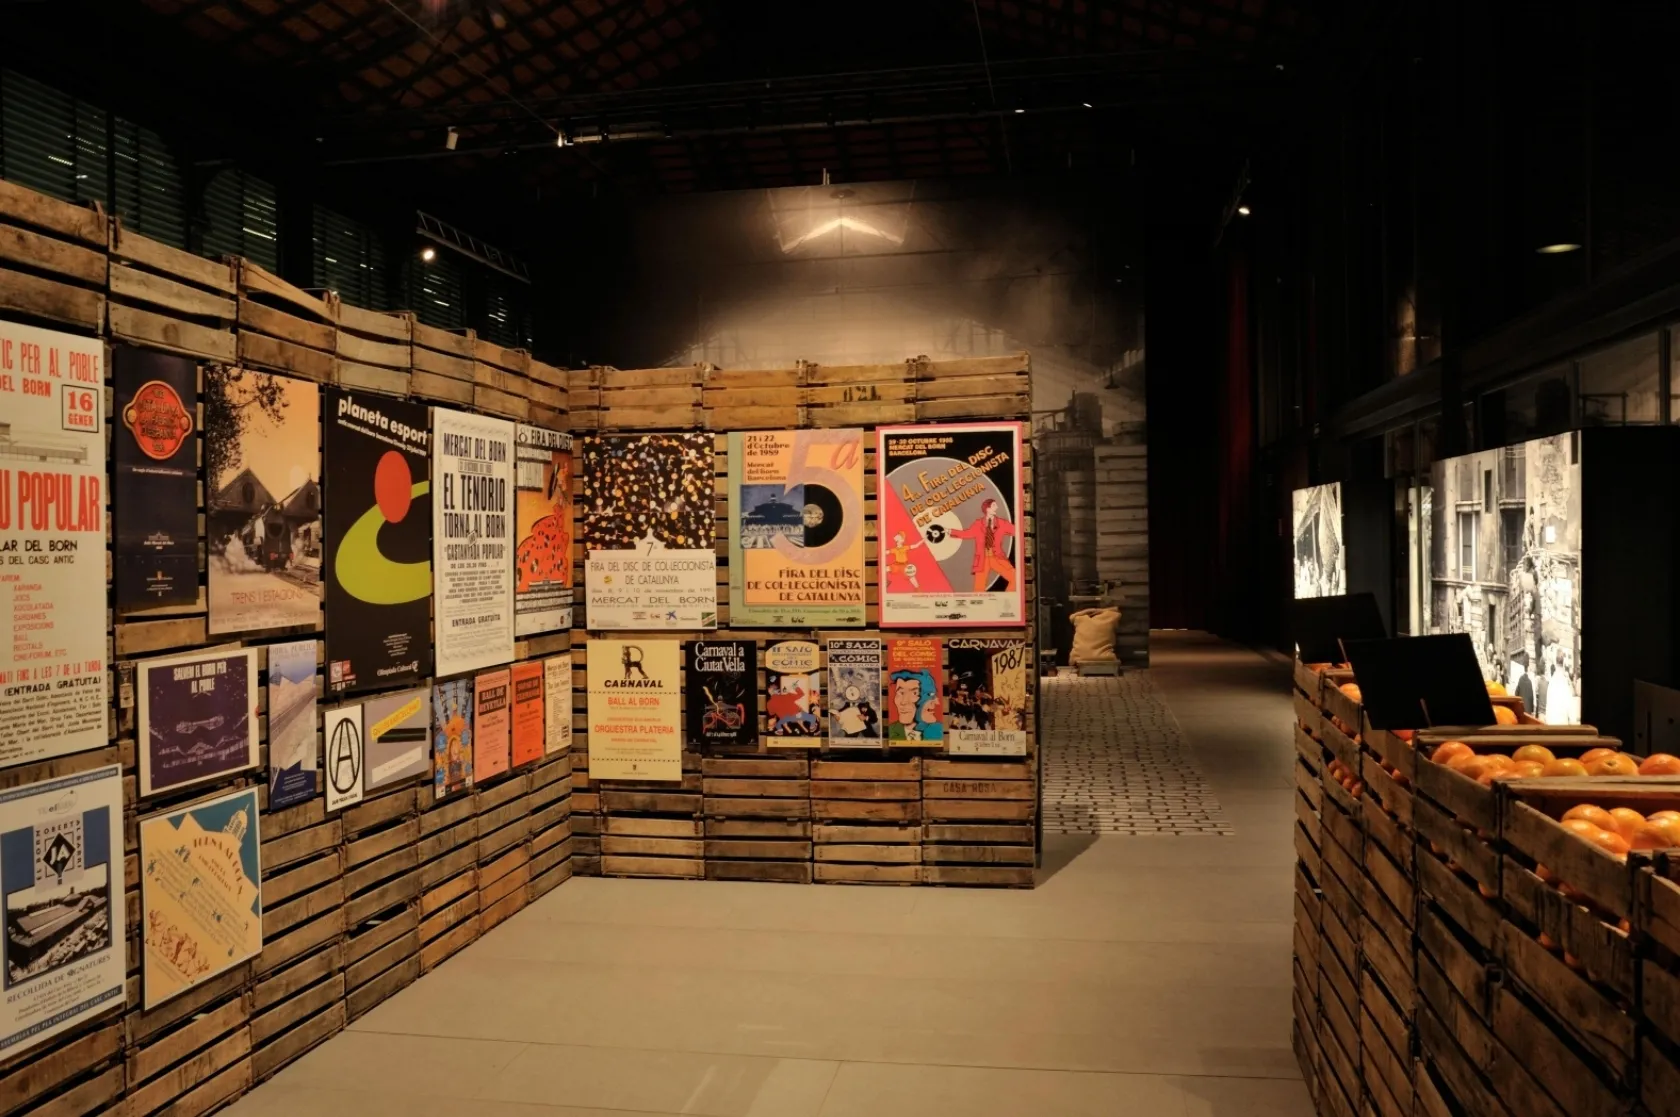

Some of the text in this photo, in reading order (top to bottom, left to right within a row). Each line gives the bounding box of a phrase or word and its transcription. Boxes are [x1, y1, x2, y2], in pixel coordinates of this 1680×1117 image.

[0, 338, 99, 384] IC PER AL POBLE
[0, 374, 52, 399] EL BORN
[68, 391, 93, 412] 16
[68, 413, 93, 427] GENER
[338, 396, 389, 430] planeta
[390, 420, 428, 445] esport
[531, 429, 546, 446] FIRA
[547, 432, 558, 448] DEL
[443, 432, 472, 458] MERCAT
[475, 437, 487, 461] DEL
[489, 440, 506, 463] BORN
[915, 443, 928, 451] DEL
[747, 462, 774, 470] Mercat
[917, 470, 948, 492] FIRA
[948, 462, 970, 479] DEL
[968, 445, 994, 466] DISC
[444, 472, 506, 513] EL TENORIO
[18, 470, 100, 532] POPULAR
[916, 482, 986, 528] DE CATALUNYA
[910, 504, 925, 517] DE
[444, 512, 506, 538] TORNA AL BORN
[25, 539, 43, 552] DEL
[49, 539, 78, 551] BORN
[8, 556, 24, 565] DEL
[28, 555, 49, 565] CASC
[54, 554, 75, 564] ANTIC
[590, 561, 605, 572] FIRA
[607, 561, 620, 572] DEL
[623, 561, 639, 572] DISC
[642, 561, 652, 572] DE
[625, 574, 680, 585] DE CATALUNYA
[809, 569, 831, 579] DEL
[747, 580, 763, 590] DE
[231, 591, 256, 605] TRENS
[263, 588, 304, 603] ESTACIONS
[591, 596, 716, 604] MERCAT DEL BORN
[779, 592, 861, 601] DE CATALUNYA
[14, 612, 47, 622] SARDANES
[452, 617, 476, 627] ENTRADA
[695, 641, 745, 661] Carnaval a
[949, 639, 1026, 651] CARNAVAL
[695, 657, 746, 672] Ciutat Vella
[994, 644, 1025, 675] 1987
[64, 663, 70, 677] DE
[74, 662, 81, 675] LA
[604, 679, 664, 689] CARNAVAL
[607, 697, 660, 706] BALL AL BORN
[594, 724, 675, 735] ORQUESTRA PLATERIA
[959, 731, 988, 741] Carnaval
[998, 731, 1015, 742] Born
[943, 782, 967, 793] CASA
[44, 820, 74, 835] OBERT
[6, 980, 52, 1005] RECOLLIDA
[54, 974, 65, 985] DE
